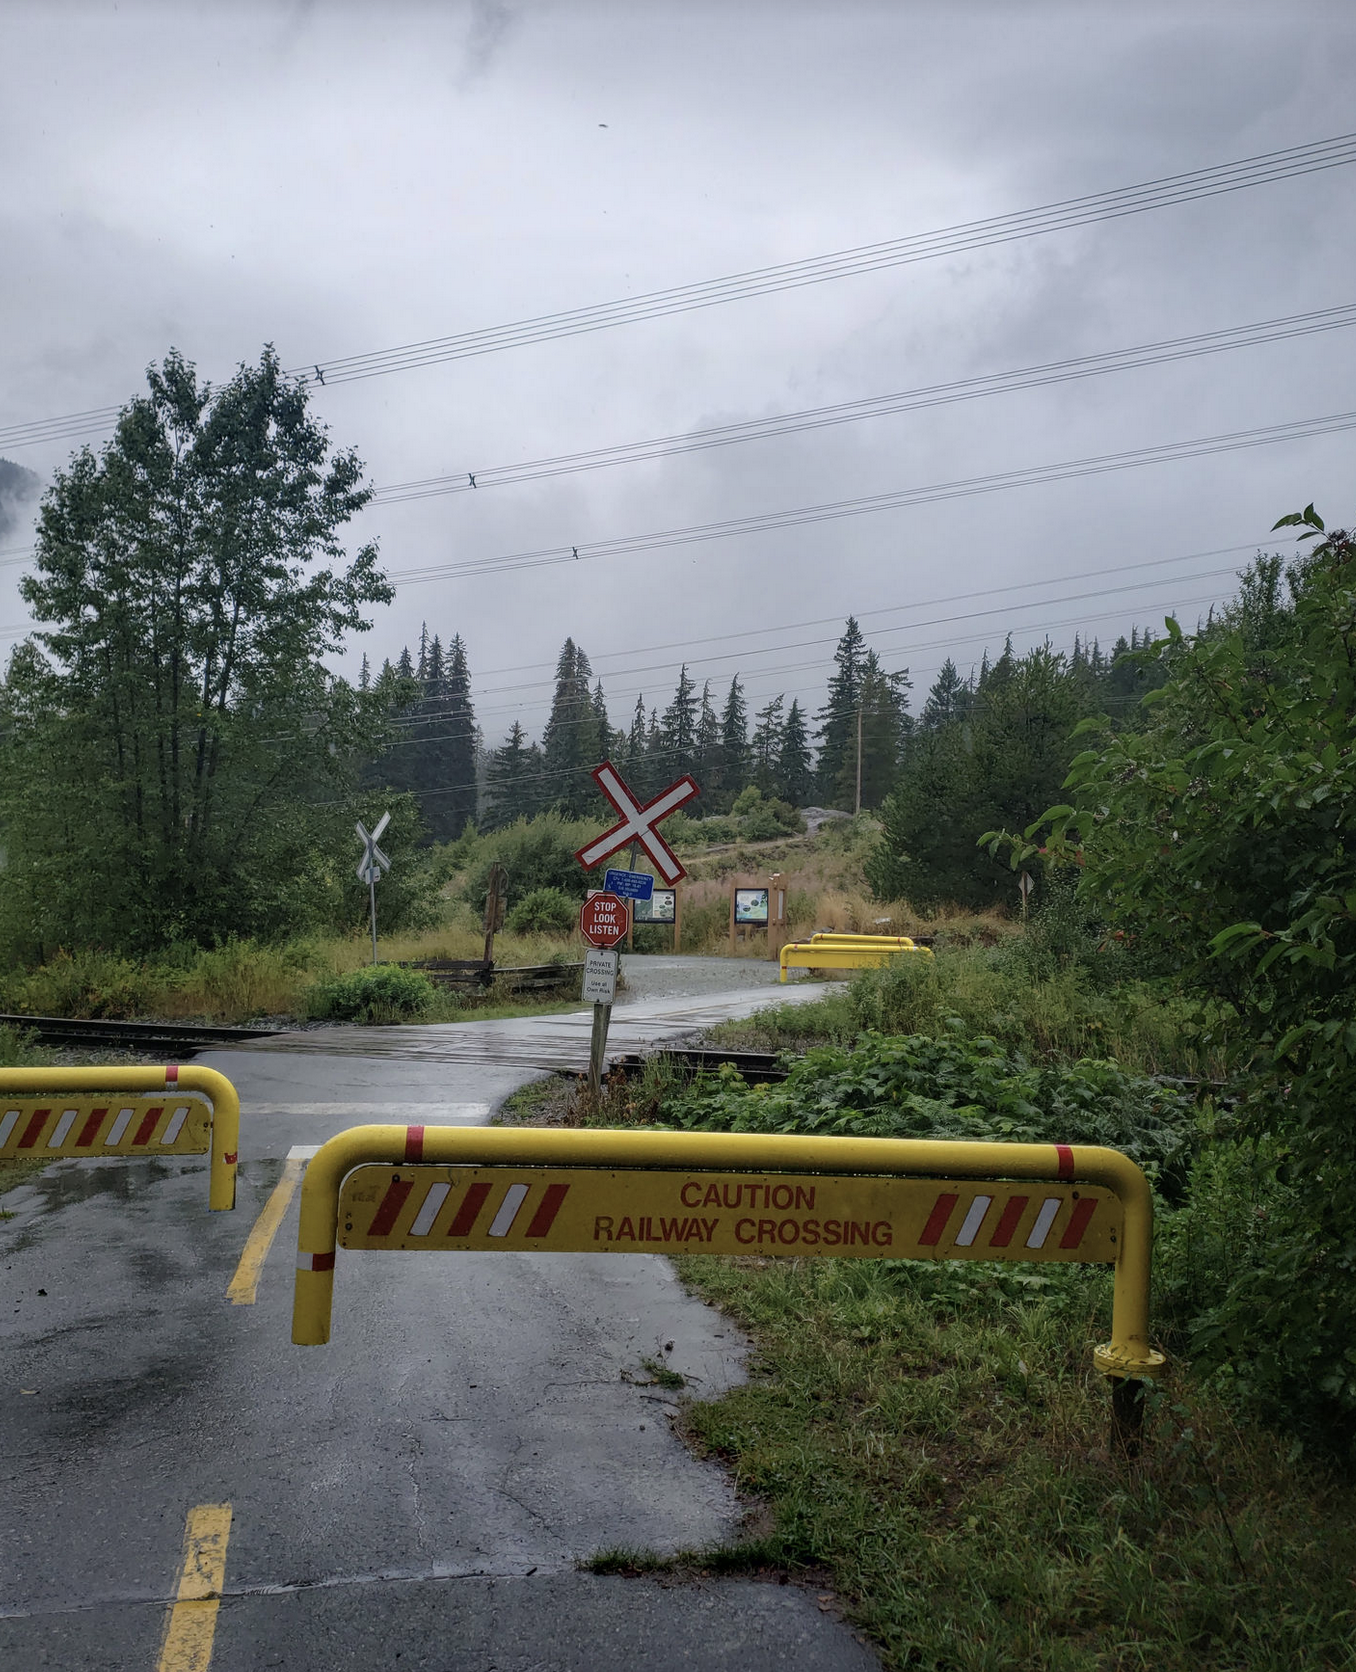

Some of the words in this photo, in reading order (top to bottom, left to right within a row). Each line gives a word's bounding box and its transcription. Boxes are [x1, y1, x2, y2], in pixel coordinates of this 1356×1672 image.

[594, 901, 616, 911] STOP
[594, 913, 616, 923] LOOK
[589, 925, 619, 935] LISTEN
[590, 960, 611, 969] PRIVATE
[586, 967, 614, 977] CROSSING
[680, 1181, 816, 1210] CAUTION
[593, 1216, 719, 1243] RAILWAY
[735, 1218, 893, 1246] CROSSING
